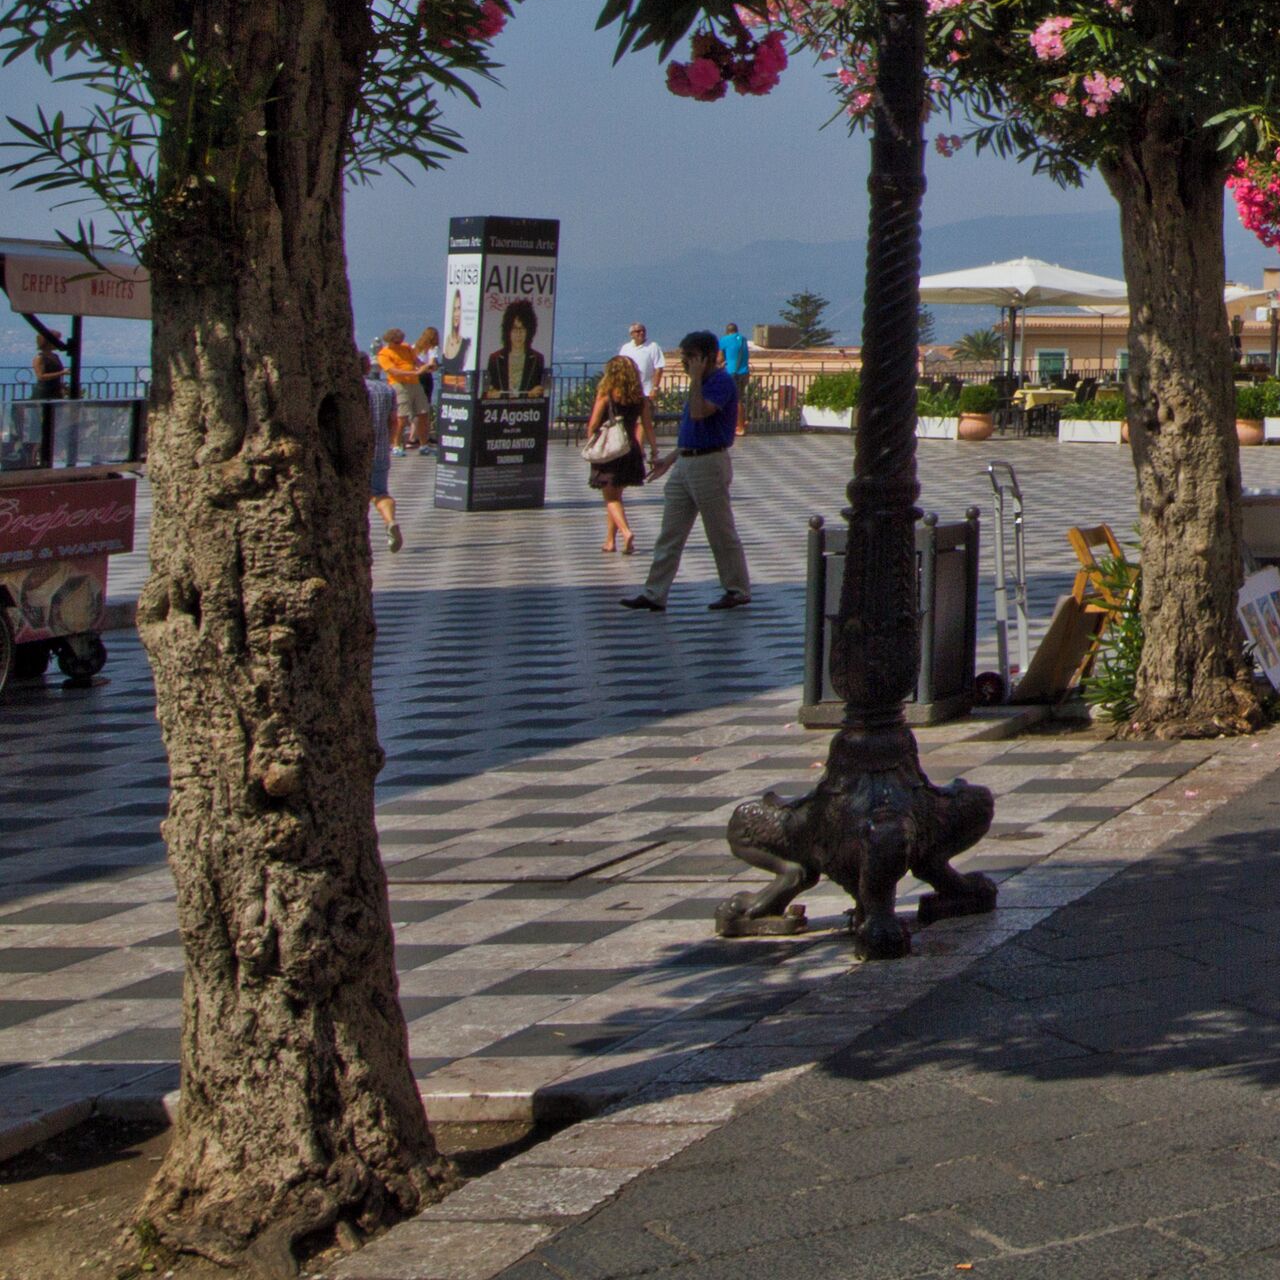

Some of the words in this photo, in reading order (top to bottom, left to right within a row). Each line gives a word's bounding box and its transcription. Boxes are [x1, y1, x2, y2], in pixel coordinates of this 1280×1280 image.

[22, 272, 67, 295] CREPES
[90, 279, 136, 300] WAFFLES
[485, 264, 555, 296] Allevi
[483, 409, 498, 423] 24
[500, 408, 541, 426] Agosto
